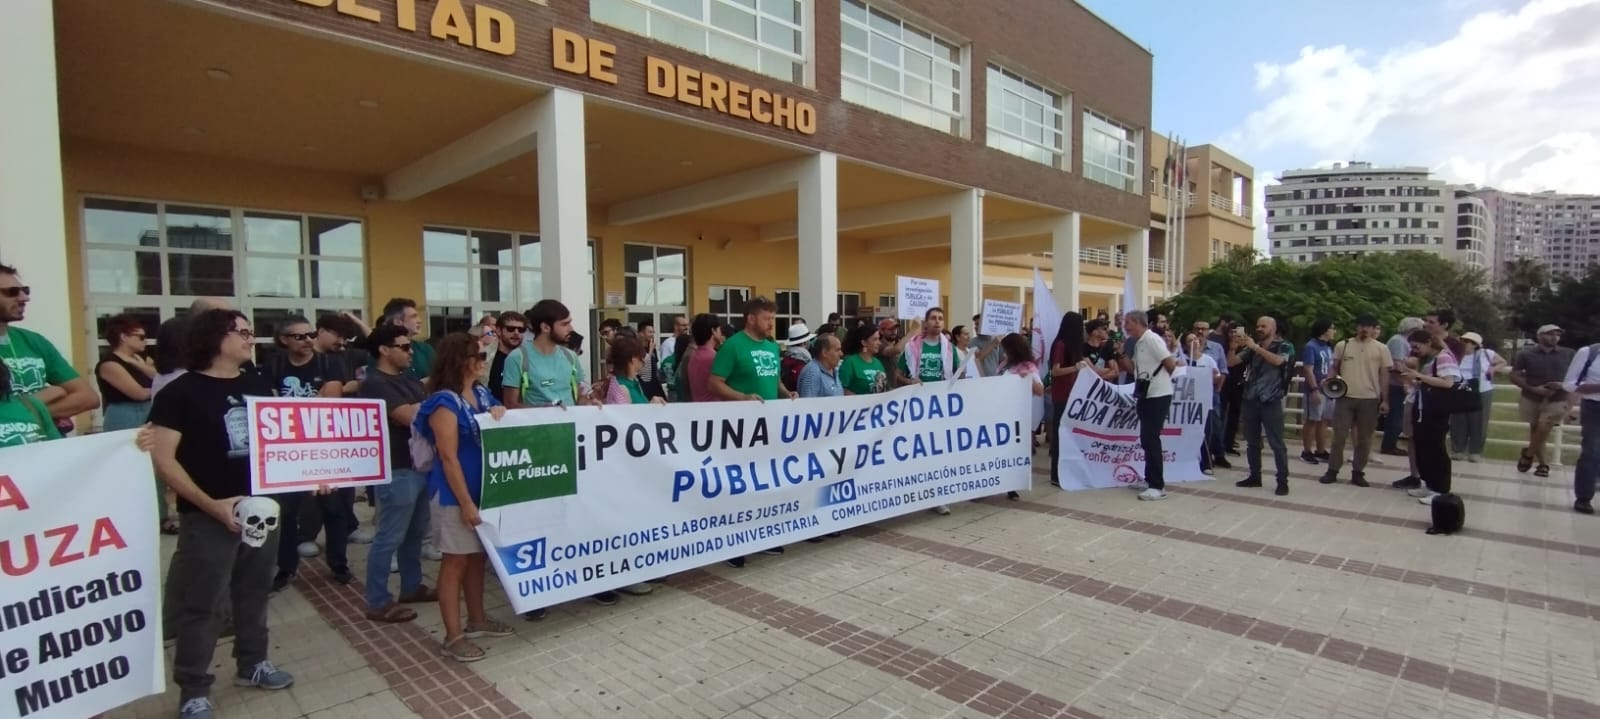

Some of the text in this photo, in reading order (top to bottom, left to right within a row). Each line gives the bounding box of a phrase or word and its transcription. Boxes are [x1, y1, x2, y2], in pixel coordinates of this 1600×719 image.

[552, 27, 618, 84] DE
[647, 55, 817, 135] DERECHO
[260, 406, 297, 441] SE
[301, 407, 381, 439] VENDE
[577, 392, 964, 471] ¡POR UNA UNIVERSIDAD
[1067, 398, 1106, 425] CADA
[266, 446, 379, 463] PROFESORADO
[302, 466, 352, 477] RAZÓN UMA
[488, 449, 532, 468] UMA
[489, 463, 569, 484] X LA PÚBLICA
[672, 420, 1021, 503] PÚBLICA Y DE CALIDAD!
[829, 456, 1031, 503] NO INFRAFINANCIACIÓN DE LA PÚBLICA
[832, 476, 1001, 521] COMPLICIDAD DE LOS RECTORADOS
[515, 500, 799, 569] SI CONDICIONES LABORALES JUSTAS
[518, 514, 819, 598] UNIÓN DE LA COMUNIDAD UNIVERSITARIA
[0, 569, 142, 632] ndicato
[39, 608, 146, 665] Apoyo
[15, 655, 130, 718] Mutuo
